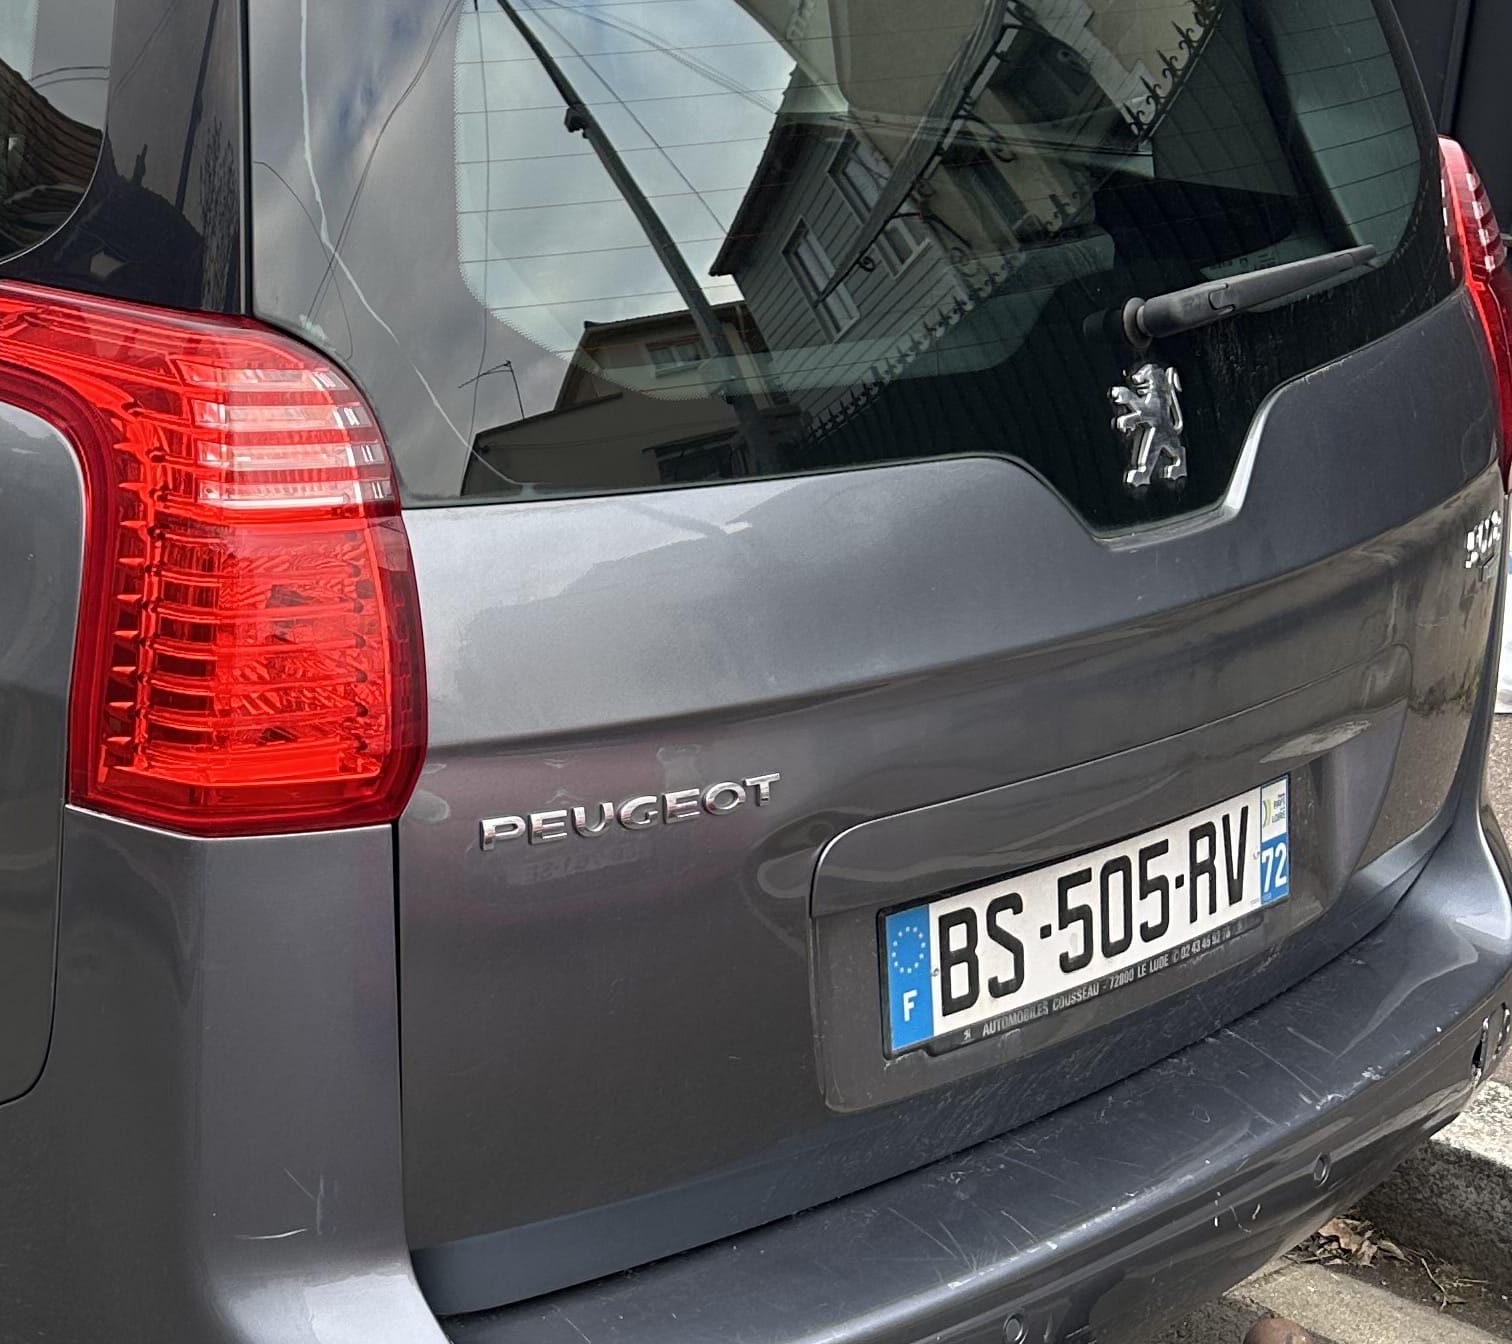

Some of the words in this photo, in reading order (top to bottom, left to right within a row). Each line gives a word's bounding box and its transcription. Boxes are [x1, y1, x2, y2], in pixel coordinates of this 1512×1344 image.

[479, 772, 781, 851] PEUGEOT
[1261, 842, 1287, 893] 72
[902, 990, 918, 1023] F
[982, 1002, 1049, 1037] AUTOMOBILES
